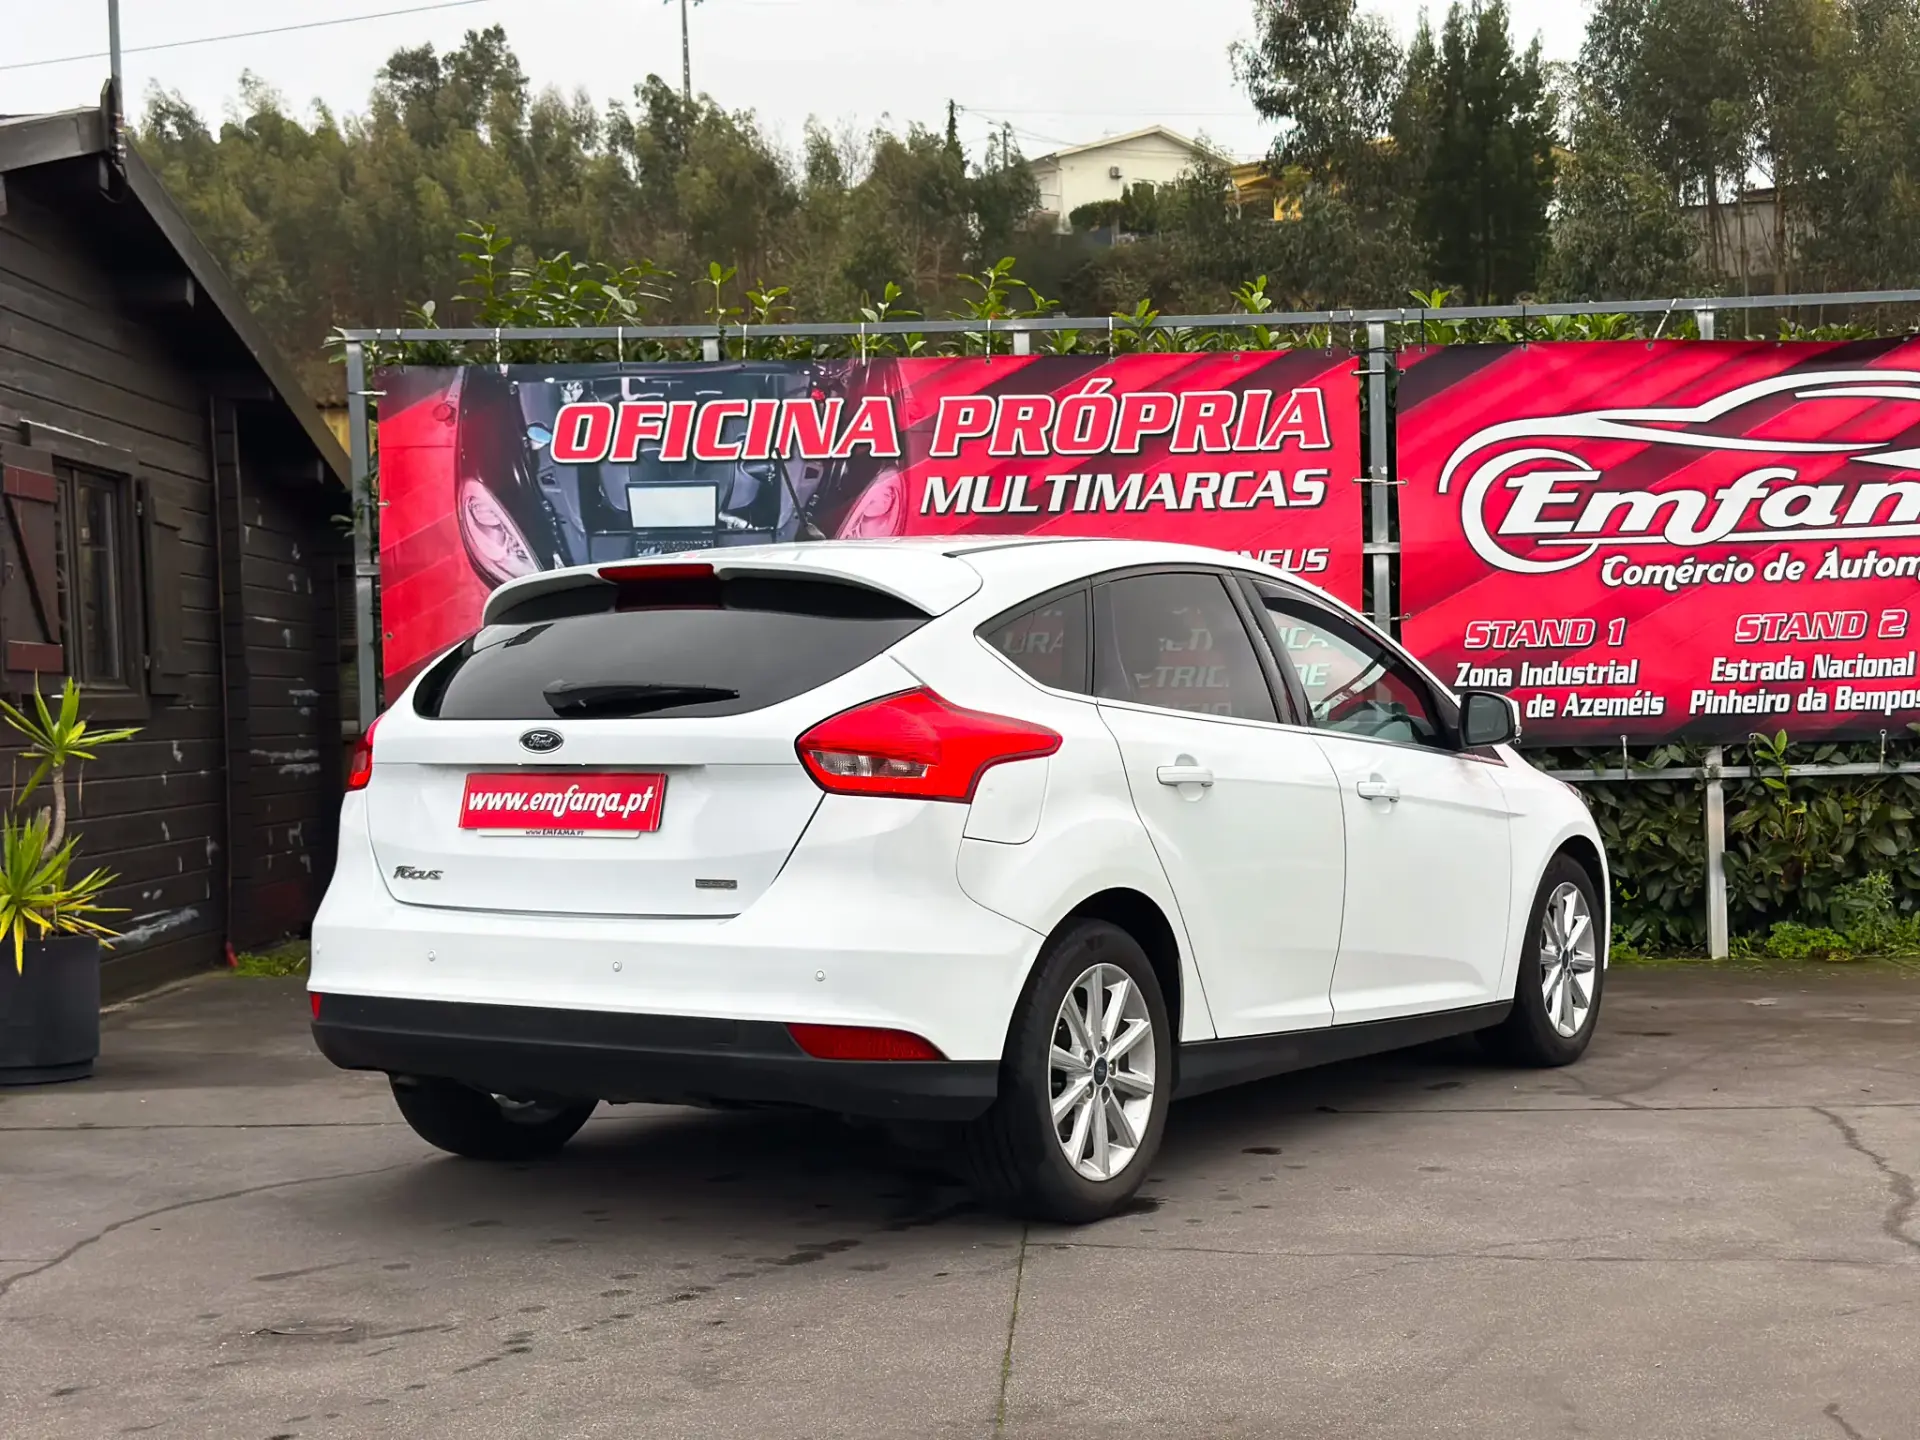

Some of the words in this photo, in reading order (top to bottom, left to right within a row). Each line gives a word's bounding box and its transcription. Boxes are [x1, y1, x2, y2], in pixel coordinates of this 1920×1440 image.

[550, 397, 901, 462] OFICINA
[930, 378, 1331, 457] PRÓPRIA
[920, 469, 1329, 514] MULTIMARCAS
[1602, 555, 1754, 591] Comércio
[1764, 552, 1805, 582] de
[1464, 618, 1596, 649] STAND
[1607, 617, 1627, 647] 1
[1735, 611, 1868, 642] STAND
[1877, 609, 1908, 638] 2
[1454, 662, 1512, 687] Zona
[1519, 659, 1637, 687] Industrial
[1711, 655, 1804, 682] Estrada
[1812, 651, 1915, 679] Nacional
[1526, 693, 1555, 718] de
[1561, 689, 1664, 717] Azeméis
[1689, 688, 1790, 714] Pinheiro
[1797, 686, 1827, 712] da
[1835, 686, 1920, 716] Bempo
[469, 784, 654, 818] www.emfama.pt
